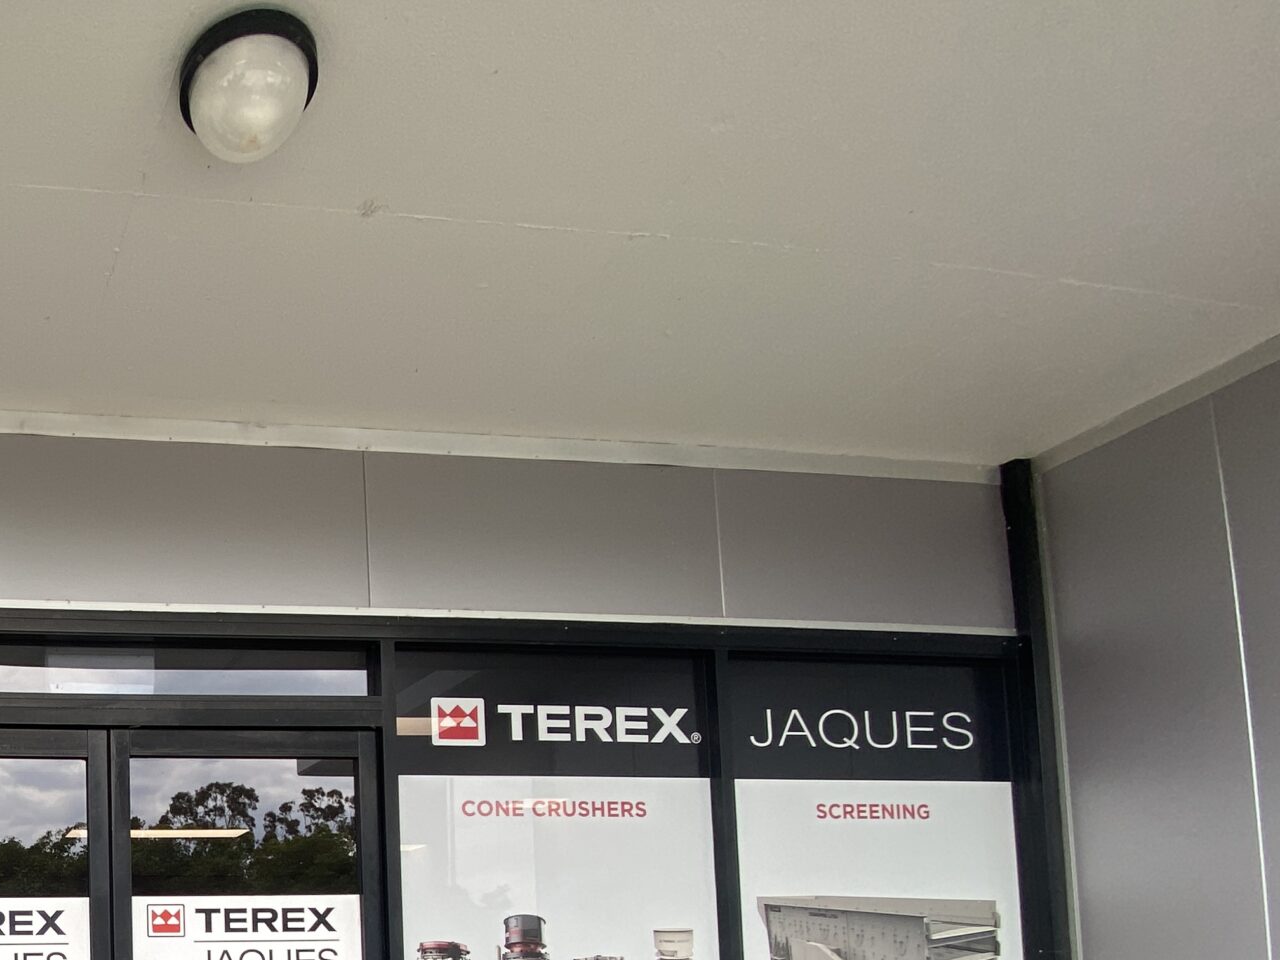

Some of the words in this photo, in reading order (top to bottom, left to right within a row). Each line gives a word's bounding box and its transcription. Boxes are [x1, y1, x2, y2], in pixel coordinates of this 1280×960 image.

[749, 708, 974, 750] JAQUES
[461, 799, 525, 818] CONE
[531, 800, 647, 818] CRUSHERS
[816, 802, 930, 820] SCREENING
[195, 907, 337, 933] TEREX
